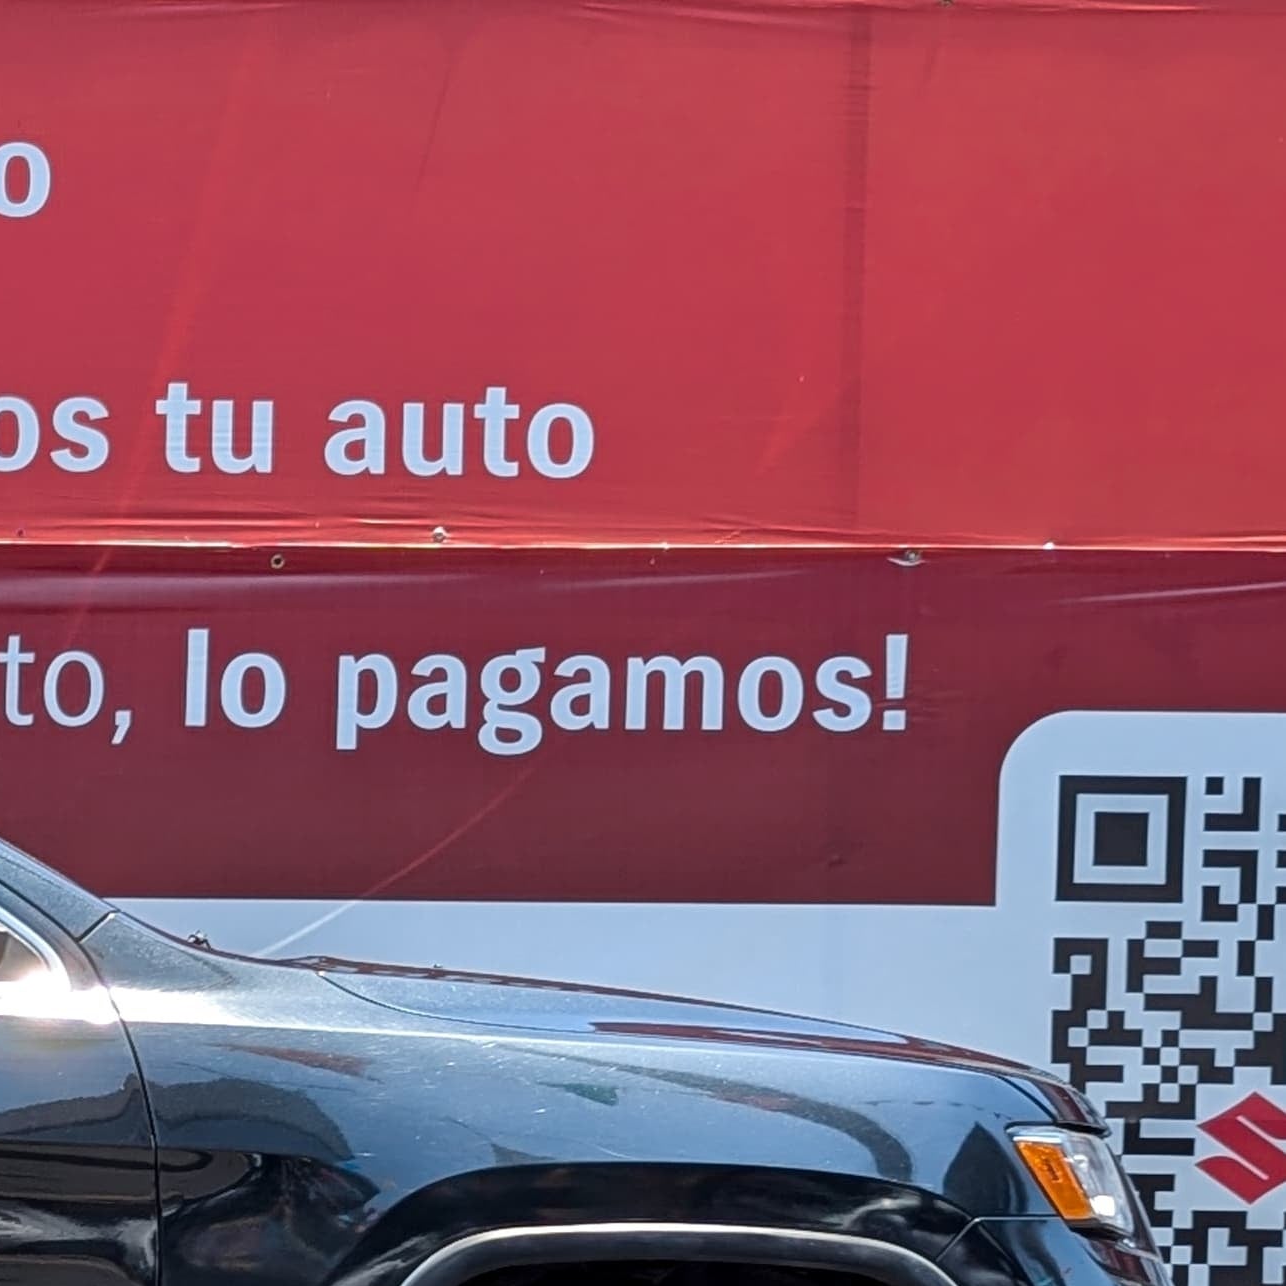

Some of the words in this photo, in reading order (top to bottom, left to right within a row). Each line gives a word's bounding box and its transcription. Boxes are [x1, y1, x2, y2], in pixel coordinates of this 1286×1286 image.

[155, 382, 274, 474] tu
[324, 386, 594, 479] auto
[185, 628, 286, 728] lo
[336, 634, 908, 755] pagamos!
